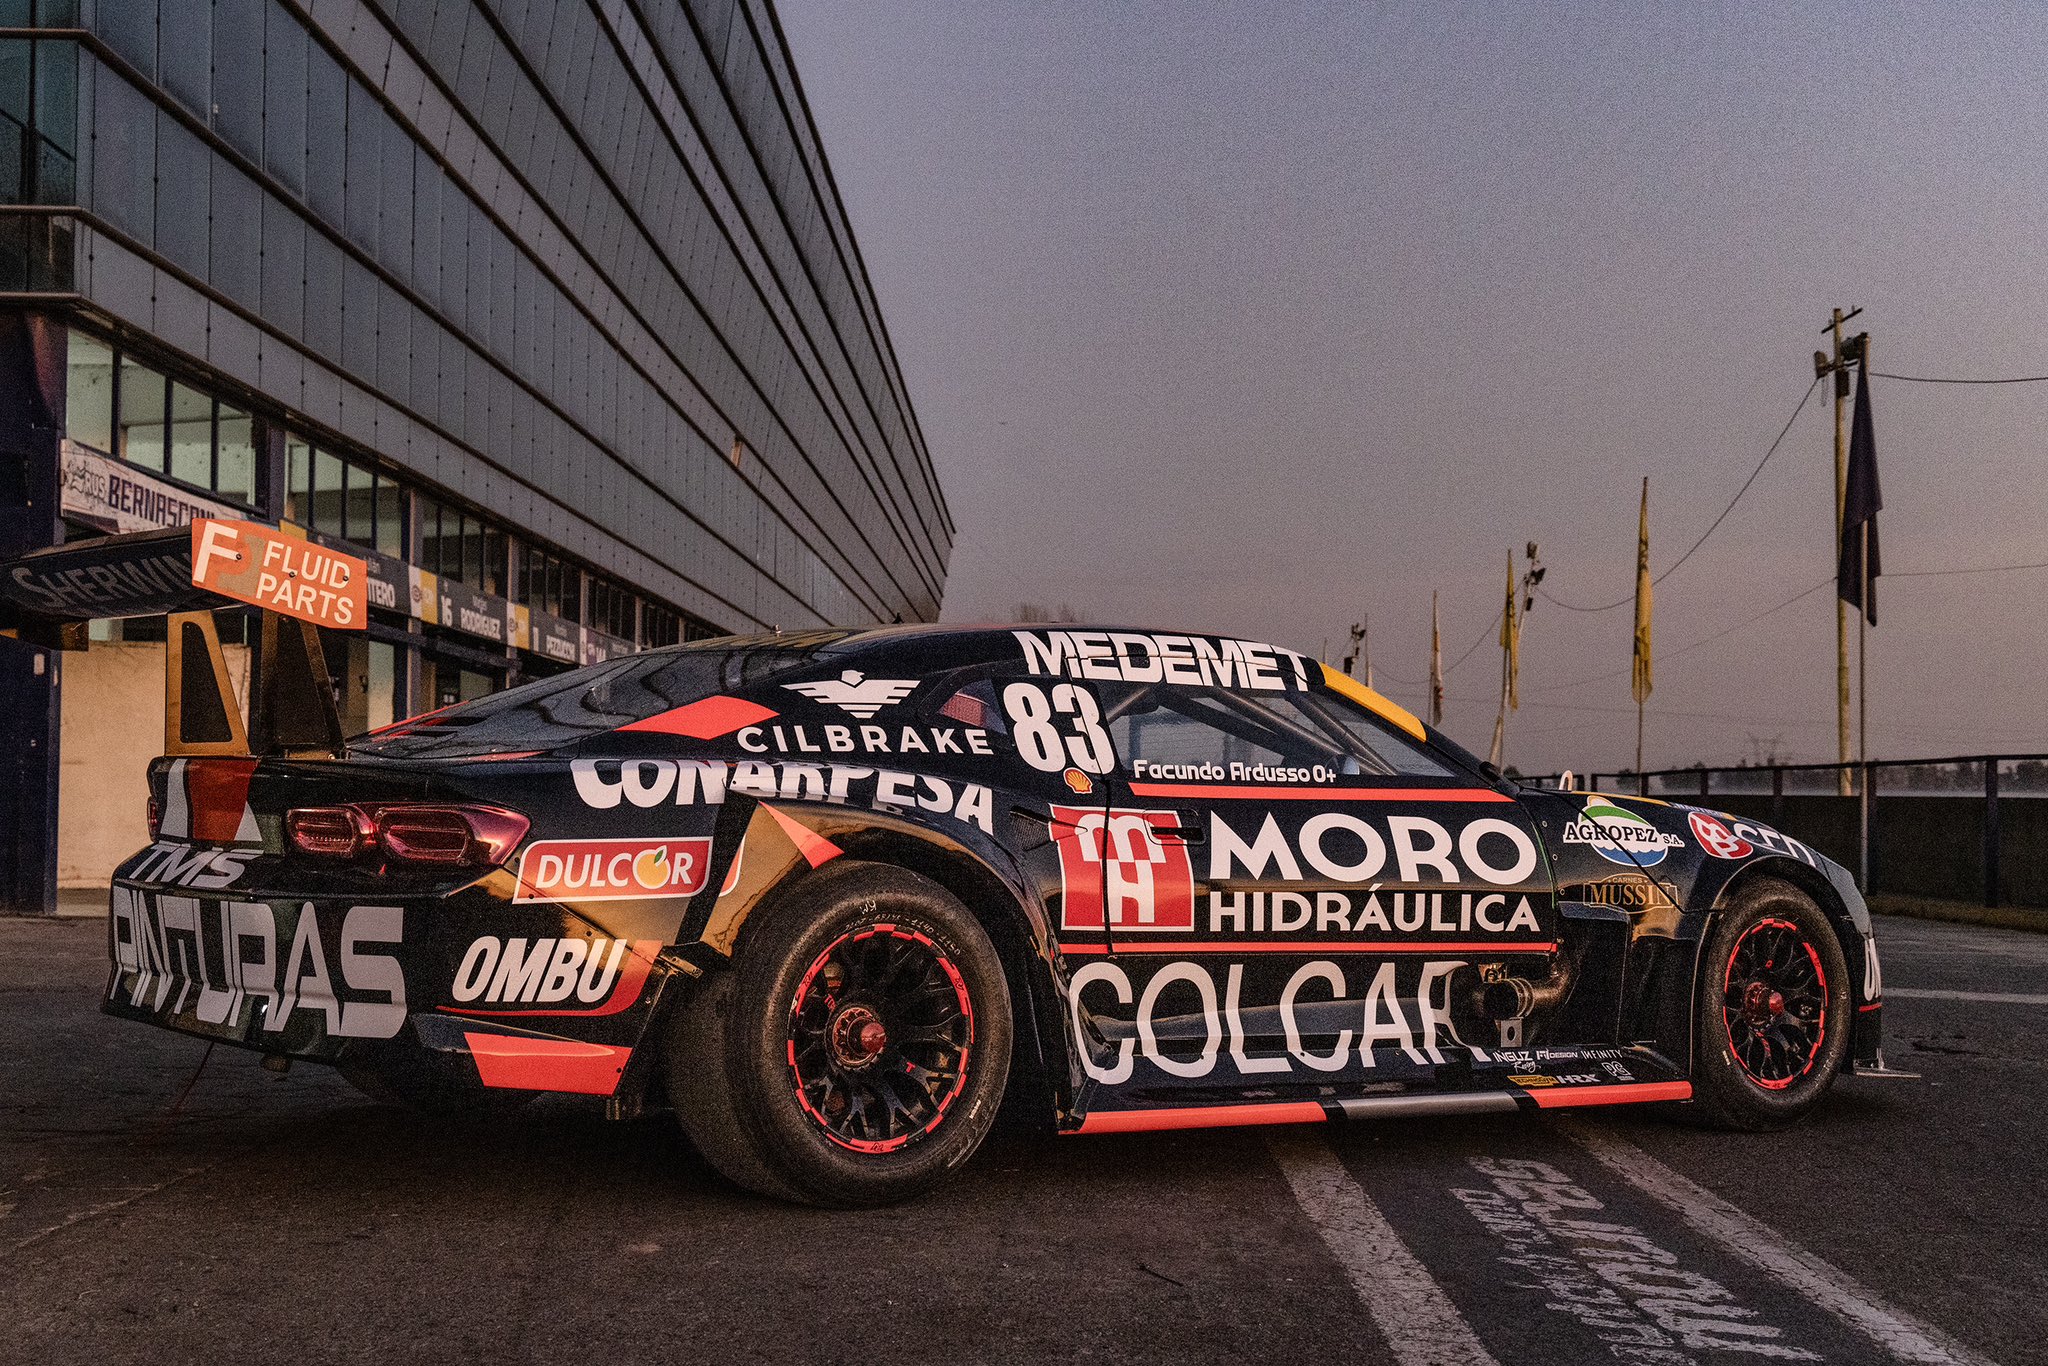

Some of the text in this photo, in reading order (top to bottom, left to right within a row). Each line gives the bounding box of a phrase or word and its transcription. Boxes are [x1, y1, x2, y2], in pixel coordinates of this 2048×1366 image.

[264, 540, 350, 589] FLUID
[256, 572, 354, 625] PARTS
[1011, 631, 1310, 693] MEDEMET
[737, 725, 995, 756] CILBRAKE
[1003, 682, 1116, 775] 83
[1133, 759, 1226, 782] Facundo
[1229, 761, 1311, 783] Ardusso
[1210, 811, 1538, 885] MORO
[1565, 822, 1658, 843] AGROPEZ
[129, 840, 265, 889] TMS
[536, 845, 693, 890] DULCOR
[1210, 884, 1541, 933] HIDRÁULICA
[108, 884, 408, 1039] PINTURAS
[451, 935, 627, 1004] OMBU
